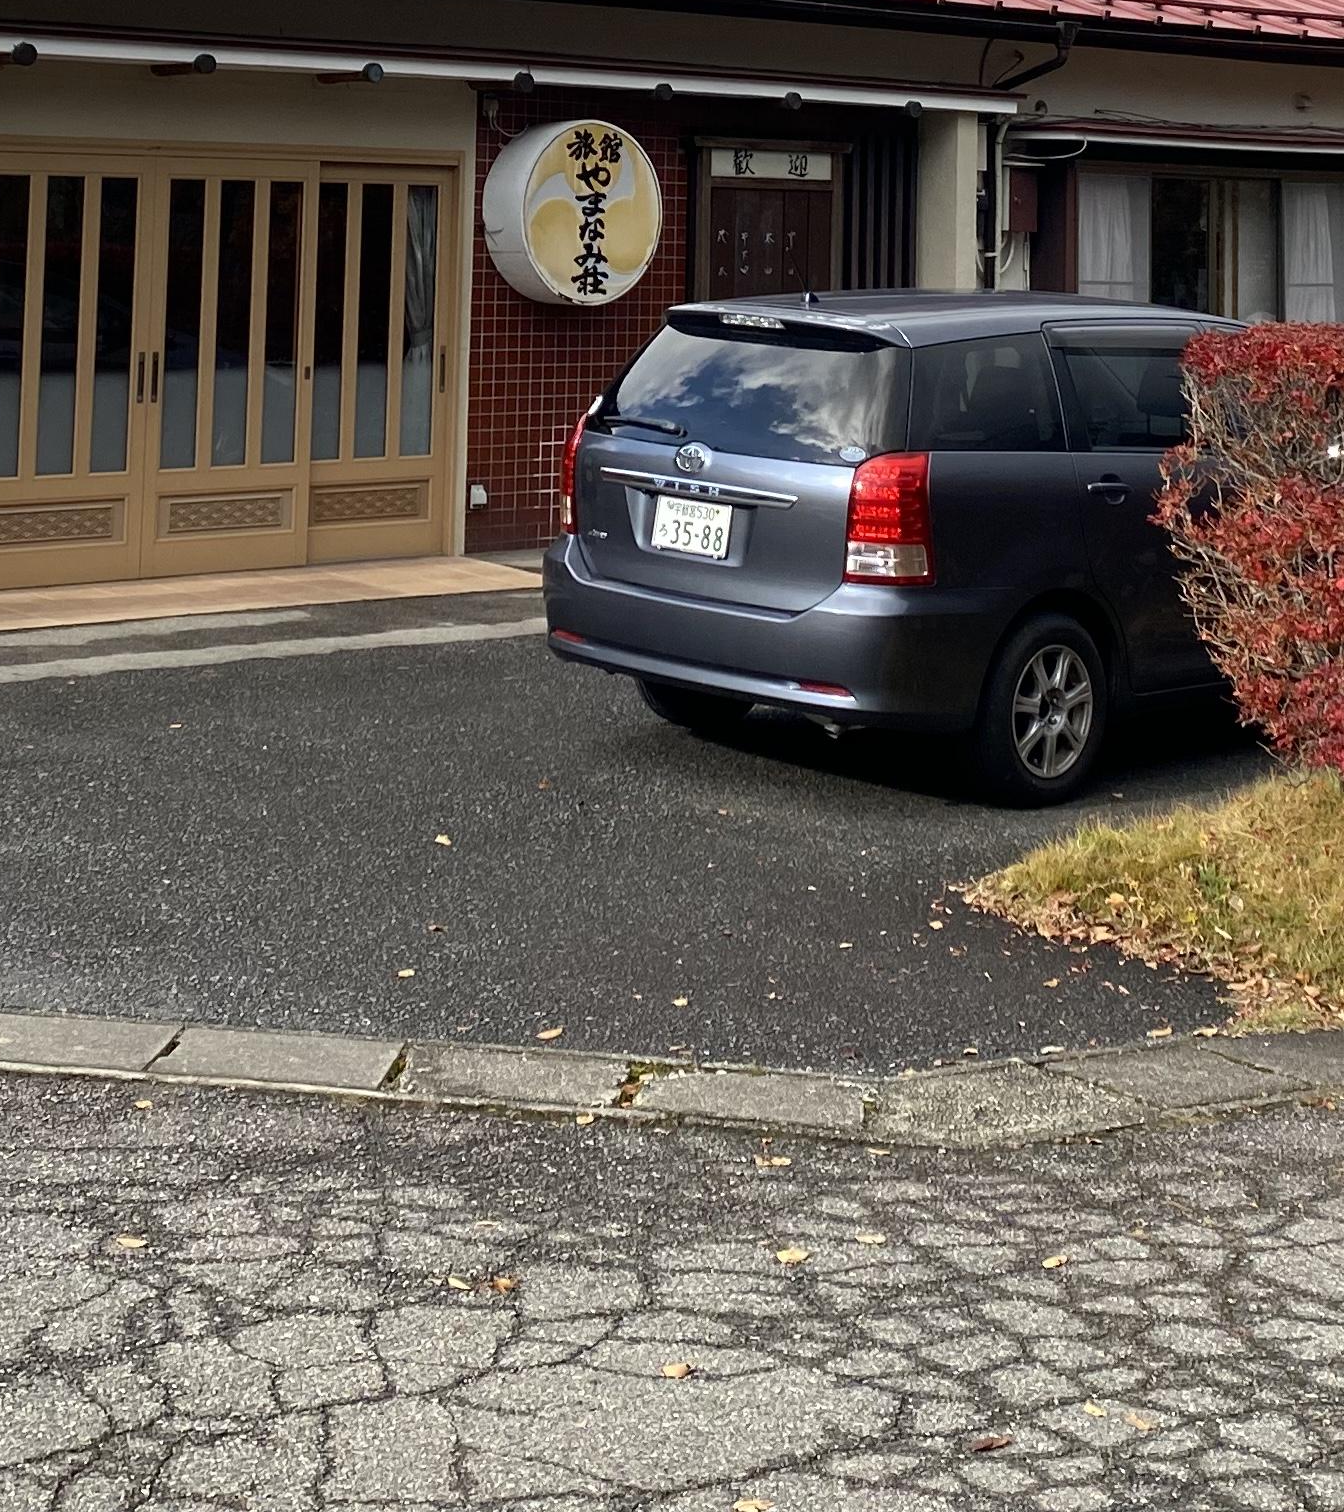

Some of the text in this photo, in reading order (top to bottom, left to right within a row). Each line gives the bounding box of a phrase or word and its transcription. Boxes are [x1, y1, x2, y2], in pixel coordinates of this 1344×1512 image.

[567, 129, 623, 163] 旅館
[571, 162, 611, 295] やまなみ荘
[654, 478, 720, 497] WISH
[670, 519, 724, 552] 35-88
